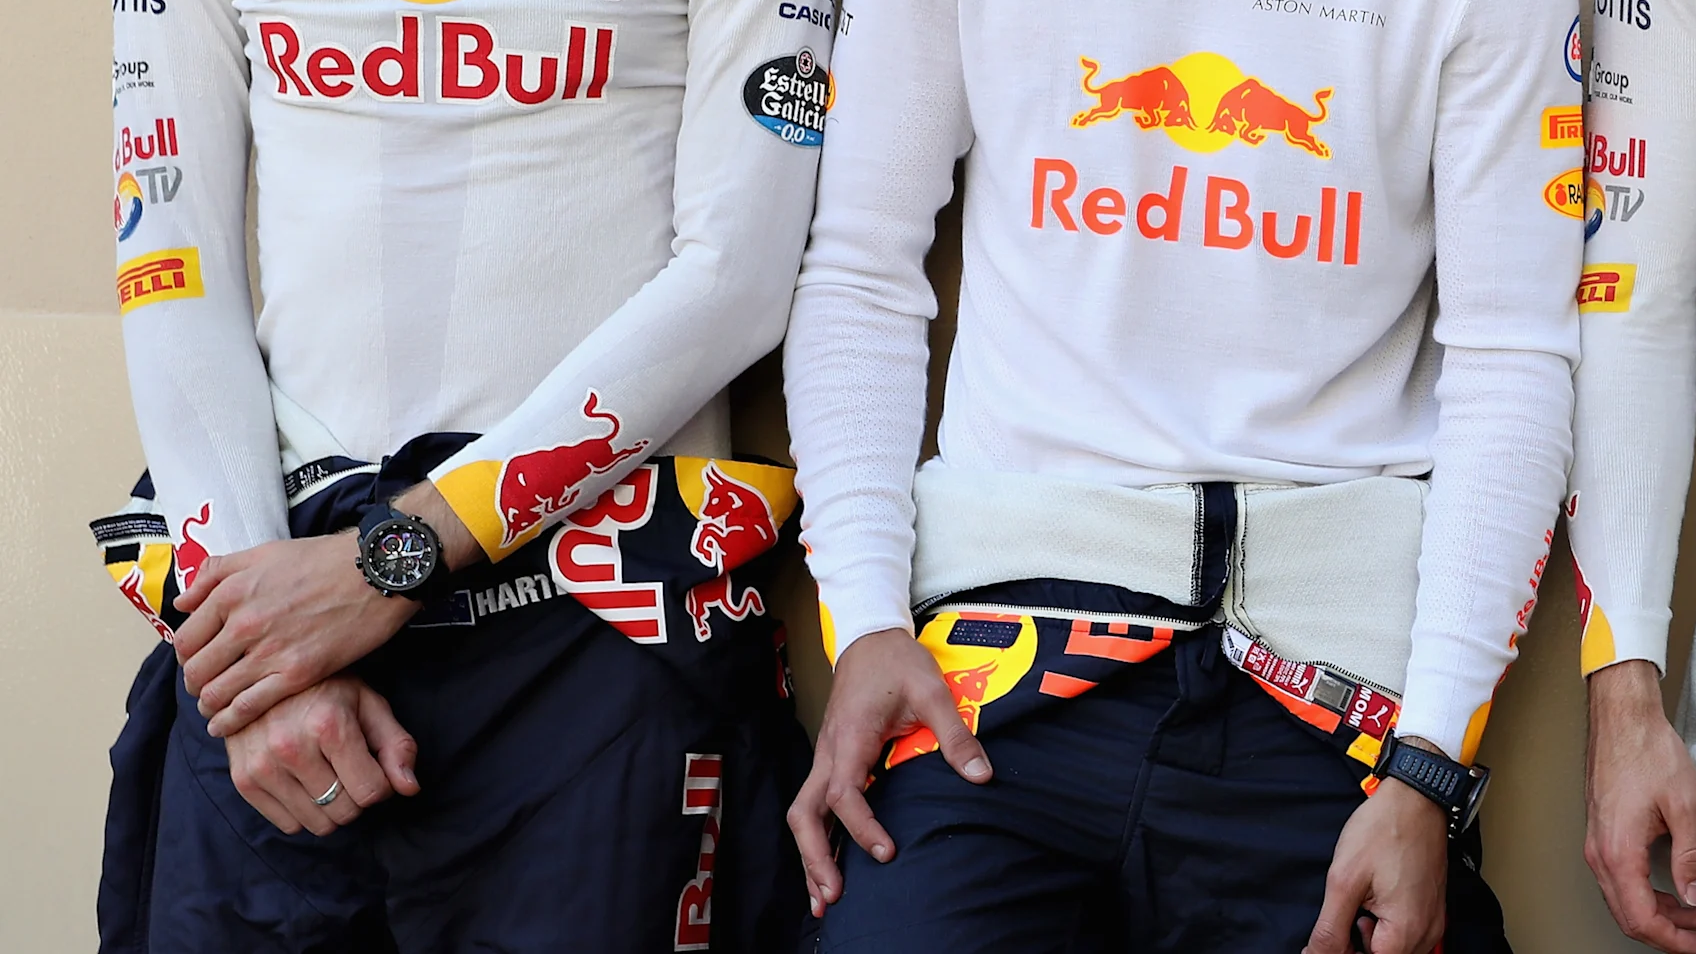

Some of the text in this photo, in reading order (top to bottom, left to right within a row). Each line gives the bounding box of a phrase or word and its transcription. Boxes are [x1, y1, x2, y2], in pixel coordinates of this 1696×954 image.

[1319, 6, 1387, 28] MARTIN
[259, 16, 613, 104] Red Bull
[1595, 62, 1629, 94] Group
[122, 118, 178, 166] Bull
[1549, 114, 1584, 140] PIR
[1592, 134, 1646, 178] Bull
[135, 166, 182, 204] TV
[1605, 185, 1645, 223] TV
[1031, 157, 1362, 265] Red Bull
